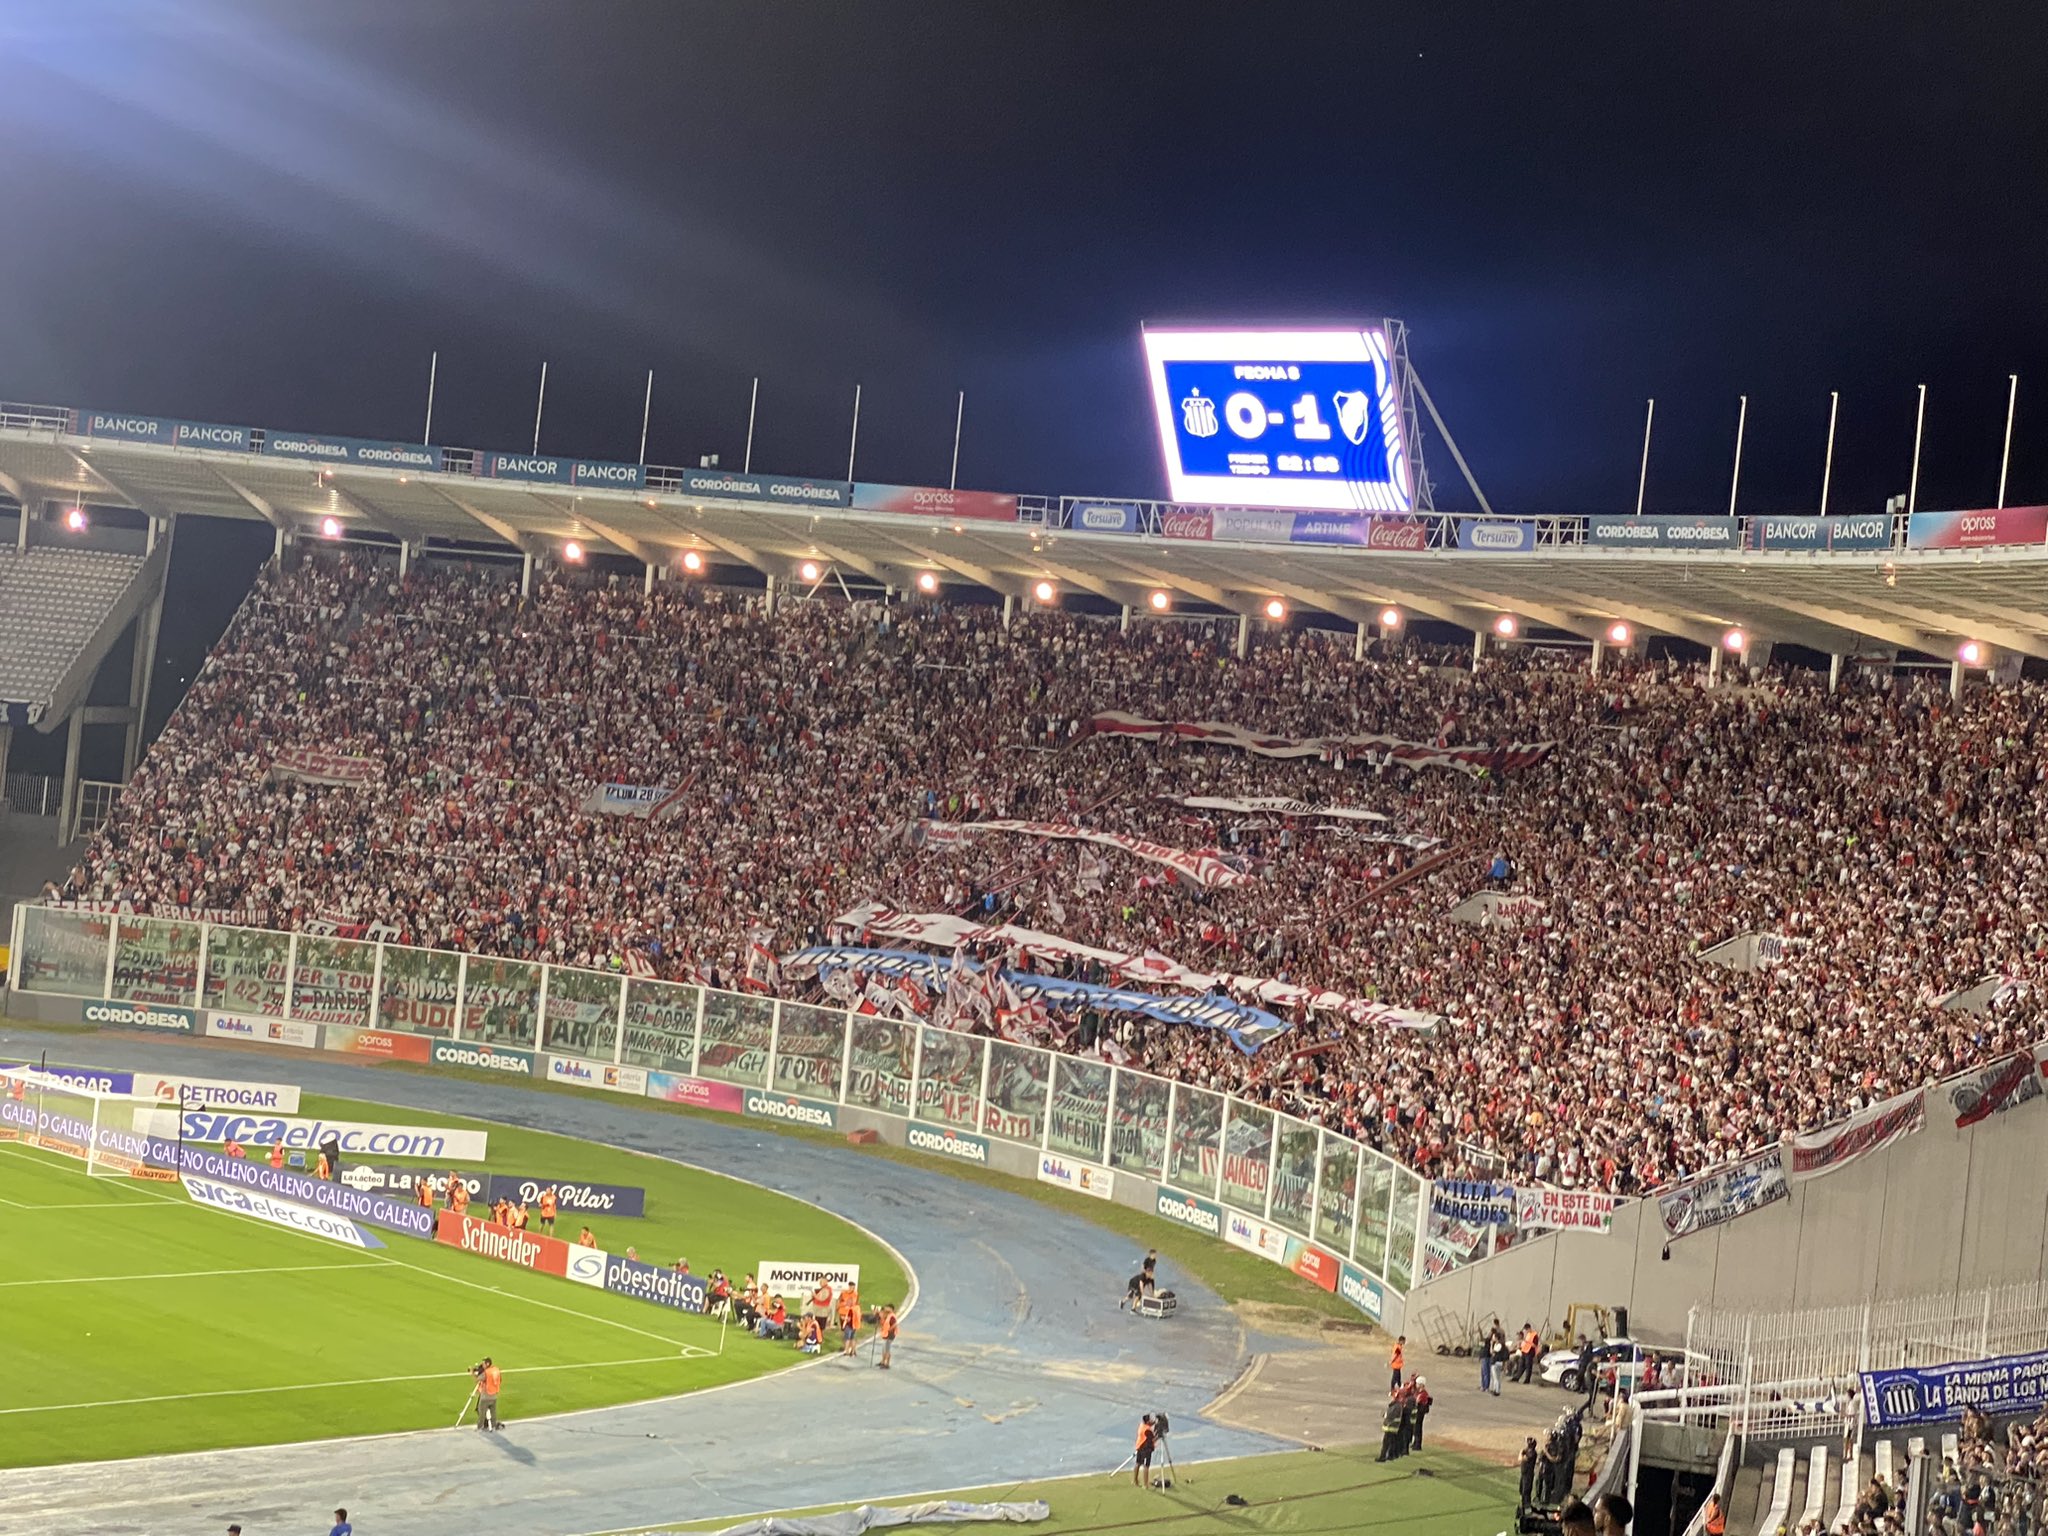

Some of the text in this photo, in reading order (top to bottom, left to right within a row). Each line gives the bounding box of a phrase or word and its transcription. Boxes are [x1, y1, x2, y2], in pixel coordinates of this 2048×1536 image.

[94, 416, 158, 435] BANCOR
[179, 425, 243, 444] BANCOR
[273, 440, 433, 465] CORDOBESA CORDOBESA
[497, 457, 558, 475] BANCOR
[577, 464, 638, 482] BANCOR
[690, 478, 841, 501] CORDOBESA CORDOBESA
[1086, 511, 1122, 526] Tersuave
[1961, 516, 1996, 534] apross
[1476, 530, 1519, 545] Tersuave
[1596, 525, 1730, 540] CORDOBESA CORDOBESA
[1766, 522, 1817, 540] BANCOR
[1833, 521, 1884, 539] BANCOR
[86, 1006, 190, 1030] CORDOBESA
[358, 1034, 393, 1049] apross
[436, 1047, 529, 1073] CORDOBESA
[178, 1084, 278, 1108] CETROGAR
[678, 1081, 710, 1096] apross
[748, 1096, 833, 1127] CORDOBESA
[908, 1129, 986, 1162] CORDOBESA
[99, 1129, 150, 1158] GALENO
[152, 1142, 204, 1171] GALENO
[205, 1156, 258, 1185] GALENO
[259, 1169, 314, 1200] GALENO
[315, 1184, 372, 1217] GALENO
[373, 1200, 432, 1234] GALENO
[388, 1173, 411, 1190] La
[1442, 1181, 1492, 1202] VILLA
[558, 1184, 615, 1210] Pilar
[1543, 1191, 1613, 1213] EN ESTE DIA
[186, 1178, 358, 1241] sicaelec.com
[1158, 1196, 1219, 1233] CORDOBESA
[1433, 1195, 1508, 1222] MERCEDES
[1541, 1209, 1601, 1227] Y CADA DIA
[461, 1216, 541, 1268] Schneider
[611, 1283, 701, 1313] INTERNACIONAL
[1343, 1274, 1381, 1317] CORDOBESA
[1945, 1374, 1961, 1386] LA
[1964, 1366, 2009, 1386] MISMA
[1923, 1383, 1942, 1409] LA
[1944, 1384, 1990, 1407] BANDA
[1992, 1382, 2010, 1400] DE
[2013, 1378, 2037, 1397] LOS
